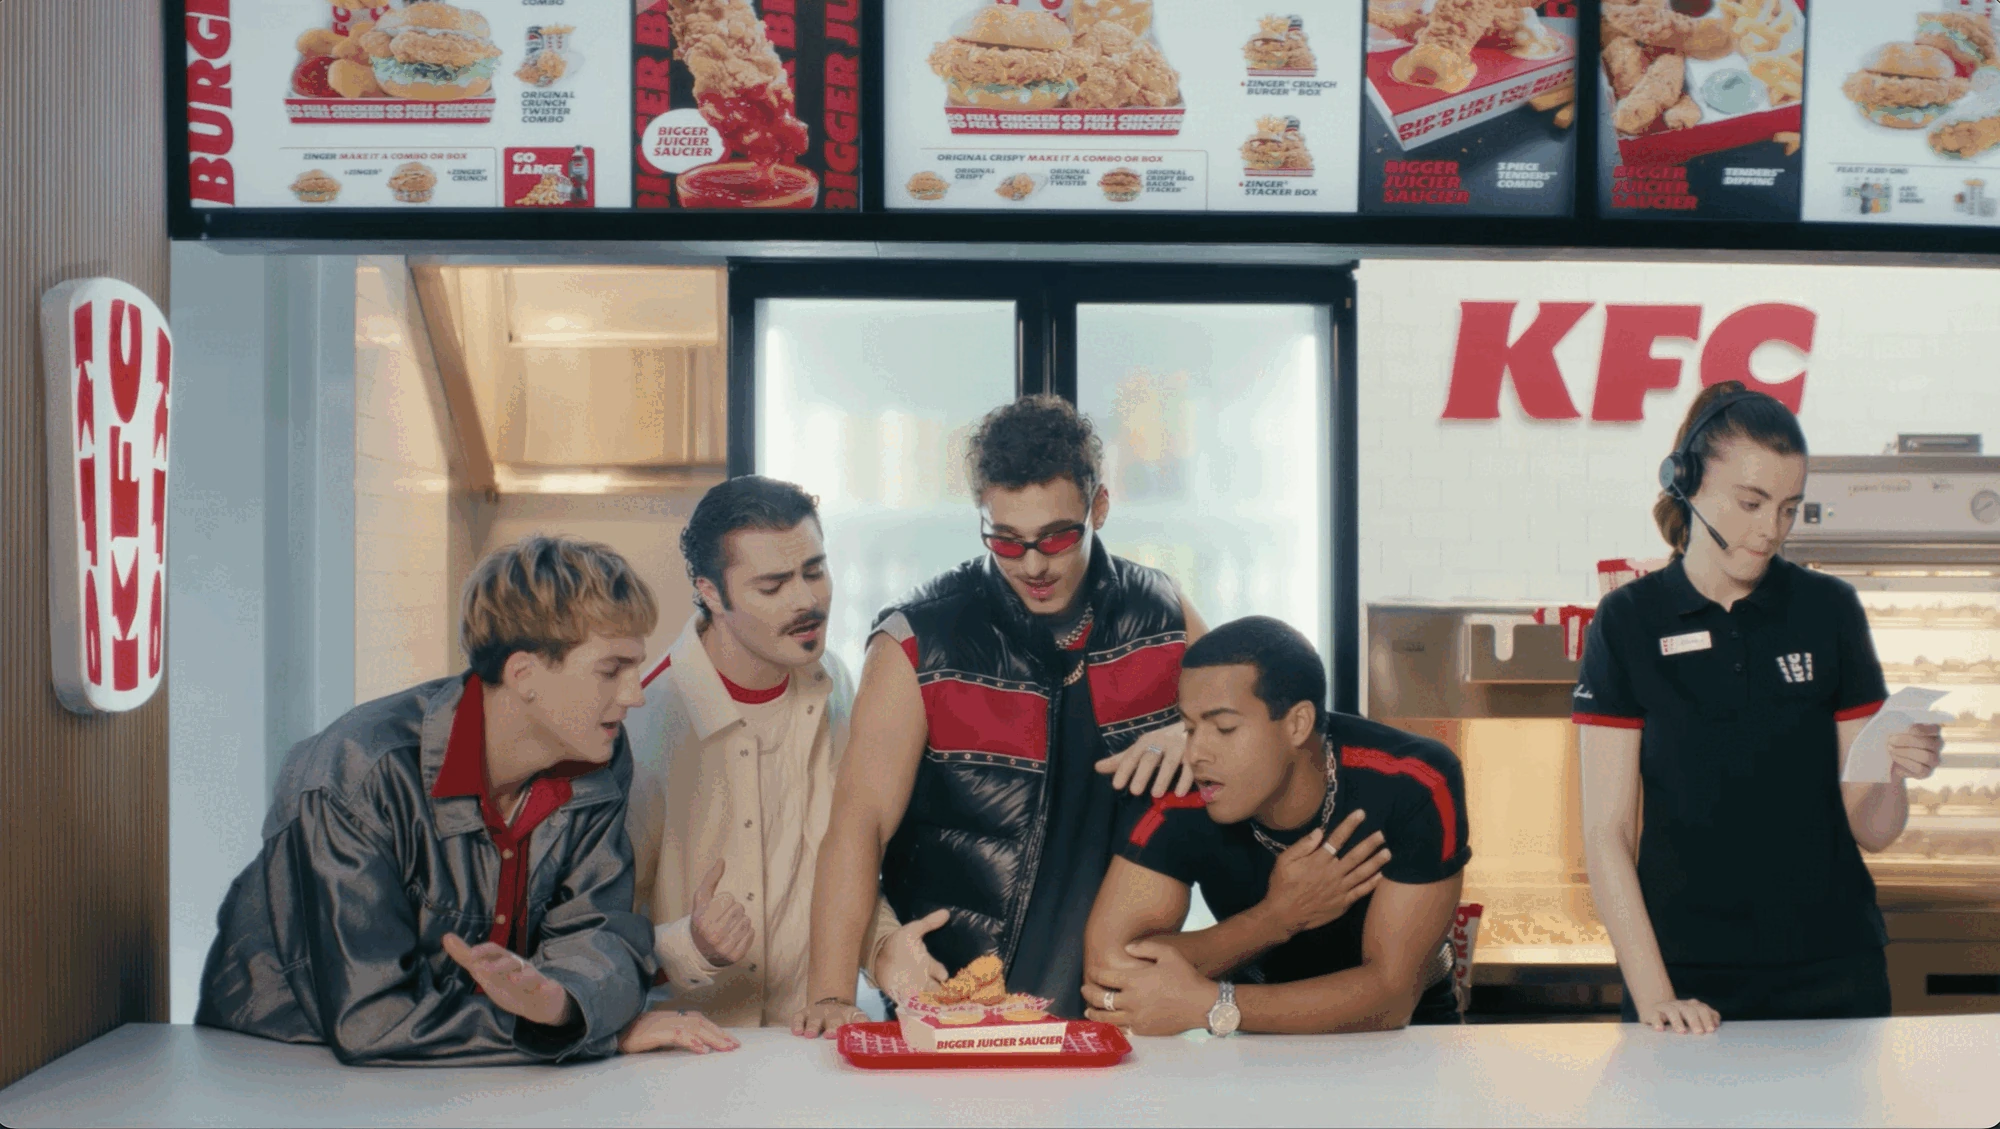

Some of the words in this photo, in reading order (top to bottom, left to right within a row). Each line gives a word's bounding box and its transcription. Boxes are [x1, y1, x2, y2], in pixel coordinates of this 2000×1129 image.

[521, 91, 575, 99] ORIGINAL
[1298, 88, 1322, 96] BOX
[521, 99, 566, 107] CRUNCH
[657, 127, 708, 136] BIGGER
[656, 137, 709, 146] JUICIER
[653, 147, 712, 156] SAUCIER
[512, 152, 536, 163] GO
[937, 154, 987, 162] ORIGINAL
[989, 154, 1026, 162] CRISPY
[1027, 154, 1059, 162] MAKE
[1082, 155, 1122, 163] COMBO
[1124, 155, 1139, 163] OR
[1141, 155, 1164, 163] BOX
[512, 165, 562, 175] LARGE
[1384, 160, 1459, 174] BIGGER
[1506, 162, 1540, 171] PIECE
[1383, 175, 1461, 189] JUICIER
[1497, 180, 1545, 189] COMBO
[1722, 177, 1775, 186] DIPPING
[1244, 188, 1292, 196] STACKER
[1383, 190, 1470, 204] SAUCIER
[1440, 299, 1819, 422] KFC
[936, 1038, 975, 1049] BIGGER
[976, 1037, 1017, 1048] JUICIER
[1018, 1035, 1063, 1046] SAUCIER
